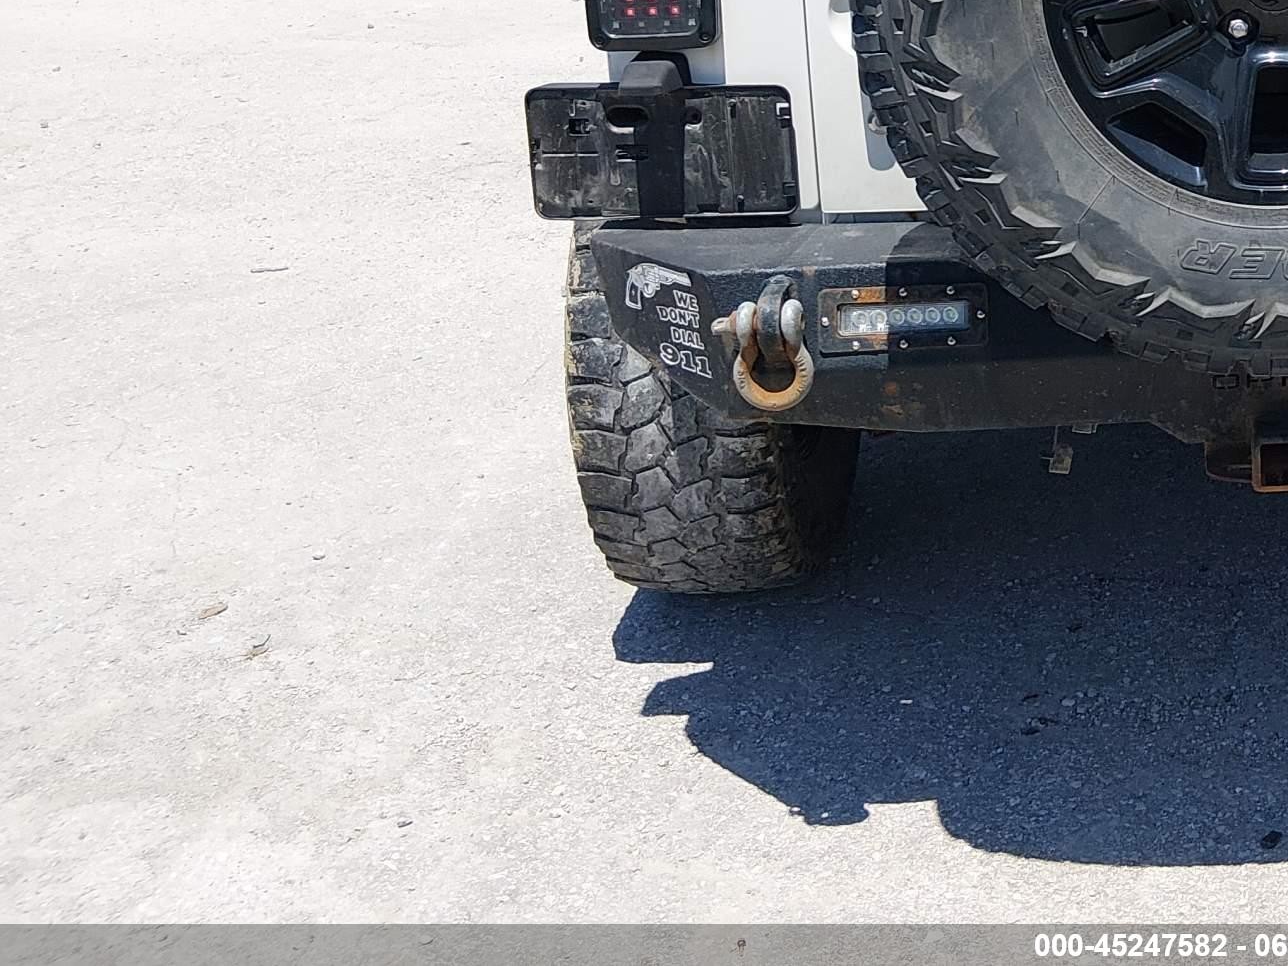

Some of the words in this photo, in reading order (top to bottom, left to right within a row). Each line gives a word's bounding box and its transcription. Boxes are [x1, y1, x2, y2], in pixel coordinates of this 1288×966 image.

[672, 289, 700, 312] WE
[656, 305, 700, 329] DON'T
[670, 326, 705, 350] DIAL
[659, 342, 713, 379] 911
